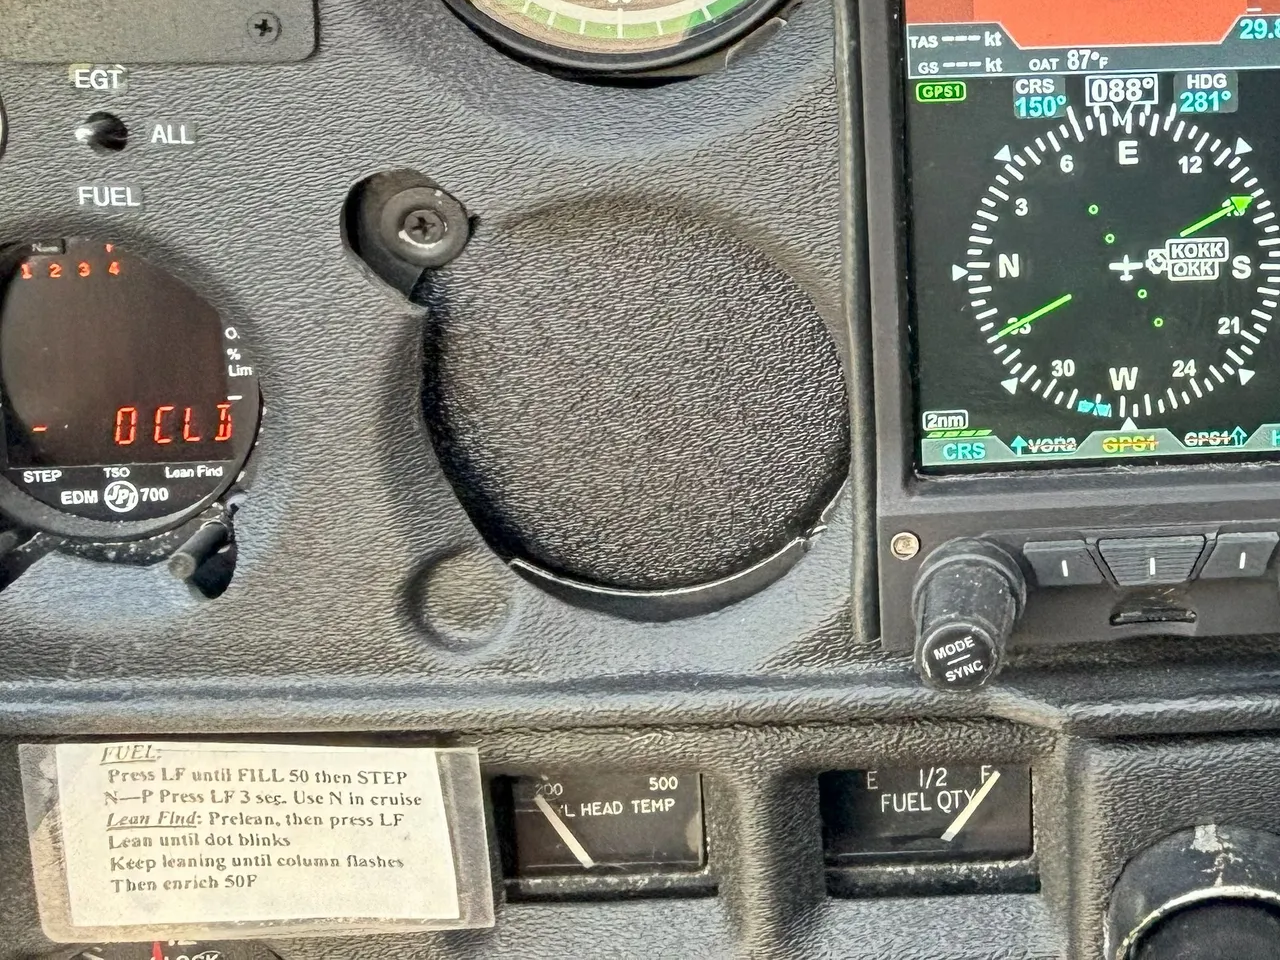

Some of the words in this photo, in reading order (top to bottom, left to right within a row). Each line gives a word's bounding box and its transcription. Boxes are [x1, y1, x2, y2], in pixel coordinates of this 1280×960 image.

[909, 36, 939, 48] TAS
[917, 62, 939, 74] GS
[1028, 58, 1059, 71] OAT
[74, 69, 123, 89] EGT
[1015, 79, 1055, 94] CRS
[1186, 73, 1228, 89] HDG
[922, 85, 961, 98] GPS1
[151, 124, 195, 144] ALL
[1118, 140, 1138, 165] E
[78, 187, 141, 207] FUEL
[1170, 242, 1224, 258] KOKK
[999, 253, 1020, 278] N
[1232, 255, 1252, 280] S
[1109, 366, 1138, 390] W
[926, 414, 965, 429] 2nm
[942, 443, 986, 460] CRS
[23, 470, 62, 484] STEP
[103, 467, 130, 478] TSO
[164, 466, 194, 478] Lean
[196, 465, 223, 477] Find
[60, 490, 98, 504] EDM
[140, 488, 169, 502] 700
[933, 635, 975, 660] MODE
[945, 660, 984, 682] SYNC
[108, 769, 156, 783] Press
[161, 767, 186, 781] LF
[192, 768, 232, 782] until
[238, 768, 285, 783] FILL
[289, 769, 309, 783] 50
[315, 770, 351, 784] then
[357, 771, 408, 785] STEP
[919, 766, 948, 789] 1/2
[160, 790, 205, 804] Press
[210, 790, 235, 804] LF
[293, 790, 324, 804] Use
[329, 791, 343, 805] N
[349, 792, 365, 805] in
[370, 792, 422, 806] cruise
[881, 792, 932, 813] FUEL
[937, 789, 976, 814] QTY
[580, 801, 624, 817] HEAD
[631, 798, 676, 814] TEMP
[106, 812, 150, 827] Lean
[285, 812, 324, 825] then
[330, 816, 374, 829] press
[379, 813, 405, 827] LF
[108, 835, 153, 850] Lean
[160, 833, 200, 847] until
[204, 833, 233, 846] dot
[238, 833, 291, 847] blinks
[110, 856, 157, 872] Keep
[162, 854, 227, 871] leaning
[231, 854, 272, 867] until
[277, 854, 340, 868] column
[346, 854, 405, 868] flashes
[110, 879, 157, 893] Then
[163, 875, 219, 891] enrich
